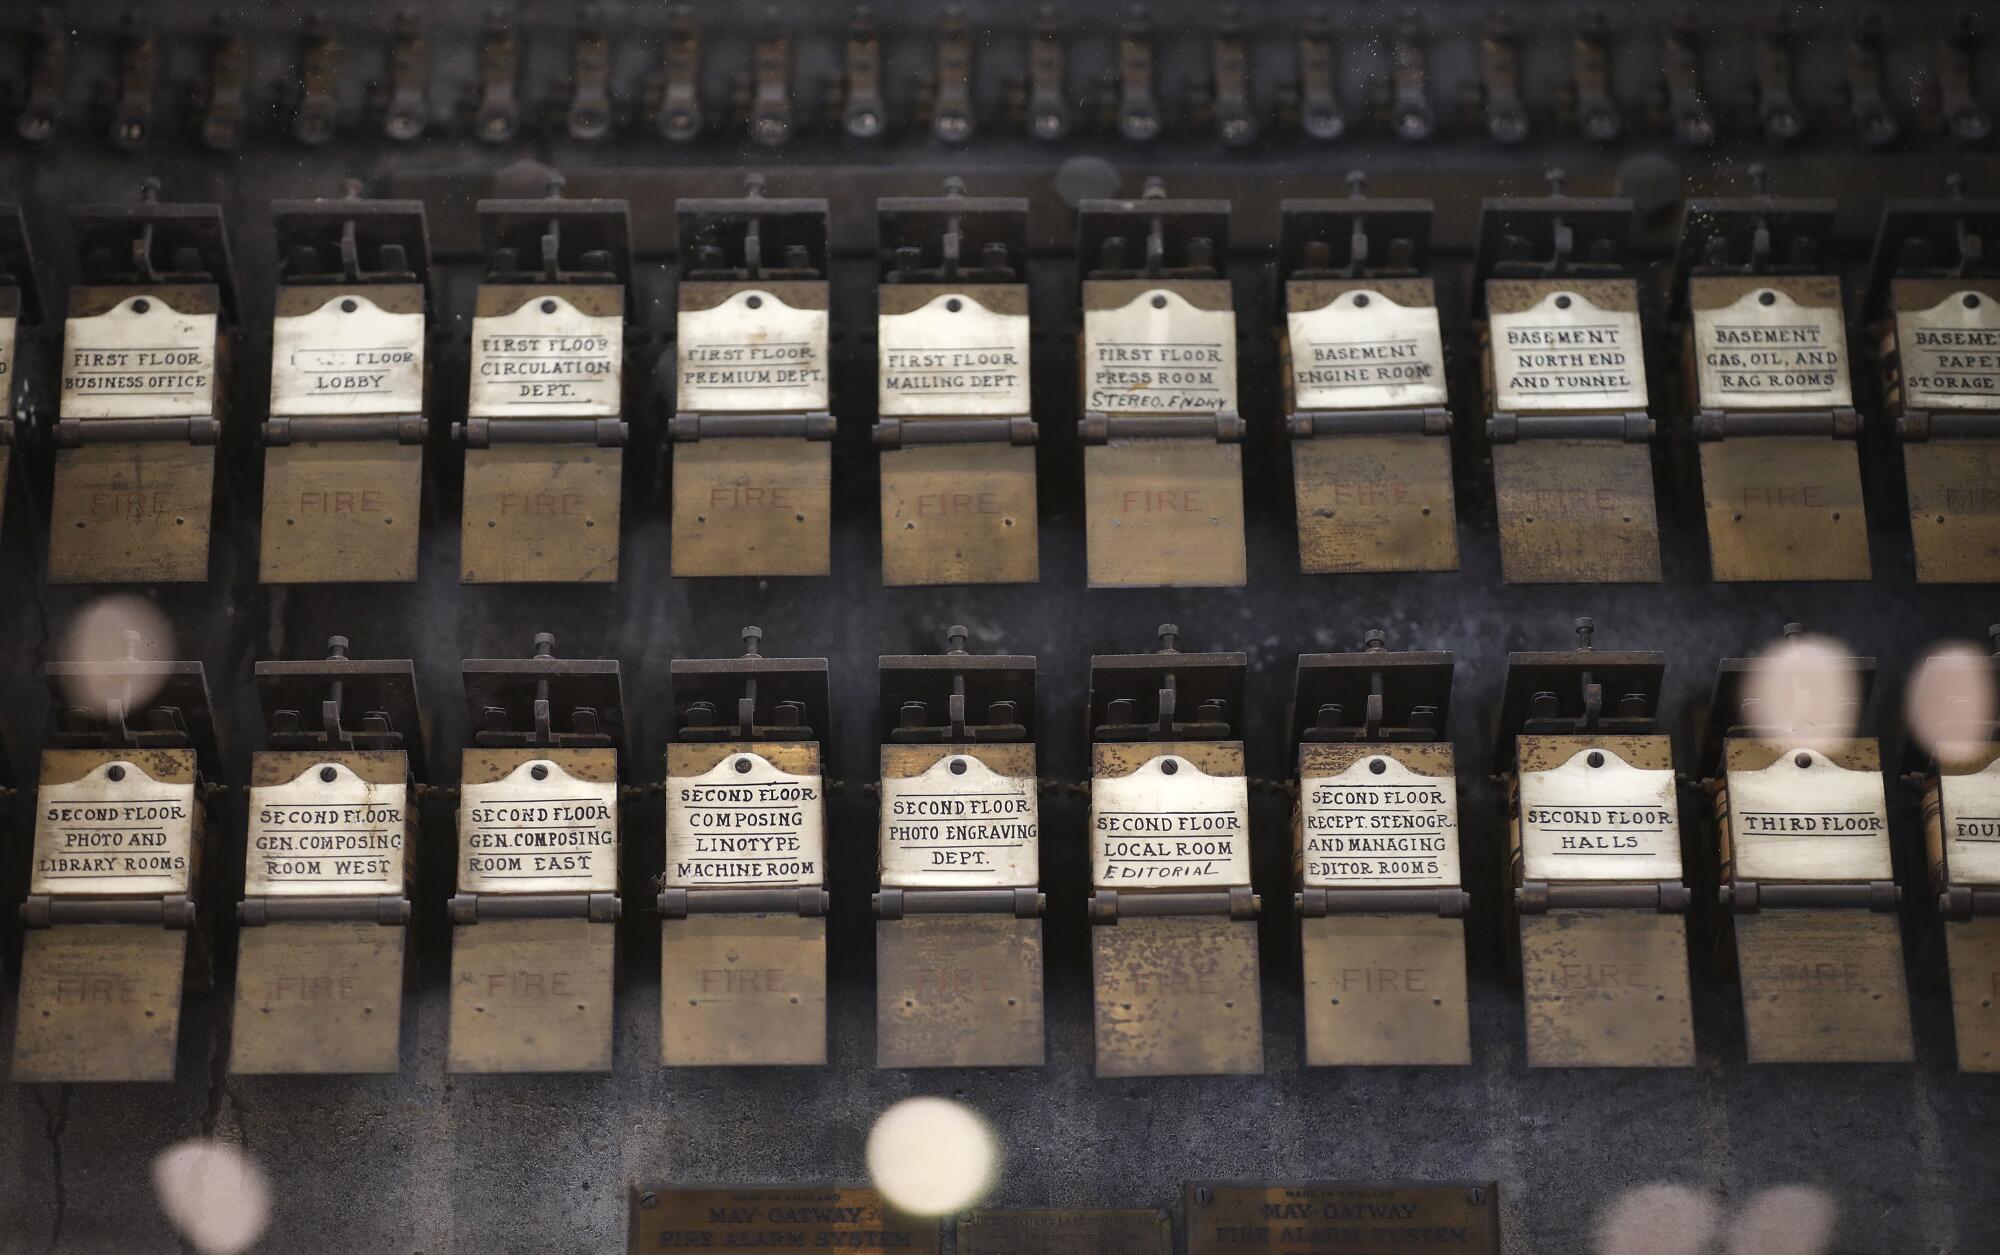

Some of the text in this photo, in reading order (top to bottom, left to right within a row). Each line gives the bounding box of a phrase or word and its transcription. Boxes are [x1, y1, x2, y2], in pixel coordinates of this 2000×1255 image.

[1507, 329, 1619, 344] BASEMENT
[1715, 329, 1821, 344] BASEMENT
[1916, 331, 2000, 346] BASEME
[481, 338, 607, 353] FIRST FLOOR
[1313, 344, 1418, 360] BASEMENT
[74, 352, 202, 367] FIRST FLOOR
[687, 348, 816, 362] FIRST FLOOR
[888, 353, 1019, 368] FIRST FLOOR
[1099, 348, 1223, 363] FIRST FLOOR
[1518, 353, 1625, 366] NORTH END
[1707, 353, 1746, 367] GAS,
[1795, 351, 1838, 365] AND
[480, 361, 611, 375] CIRCULATION
[684, 368, 825, 383] PREMIUM DEPT.
[1298, 364, 1431, 383] ENGINE ROOM
[65, 375, 206, 390] BUSINESS OFFICE
[315, 375, 385, 389] LOBBY
[886, 375, 964, 389] MAILING
[1095, 370, 1213, 384] PRESS ROOM
[1509, 375, 1631, 388] AND TUNNEL
[1721, 372, 1835, 388] RAG ROOMS
[1908, 377, 1994, 390] STORAGE
[520, 384, 576, 397] DEPT.
[710, 487, 793, 510] FIRE
[1122, 489, 1203, 514] FIRE
[1333, 483, 1414, 505] FIRE
[1743, 486, 1823, 509] FIRE
[90, 492, 171, 515] FIRE
[300, 491, 385, 514] FIRE
[502, 494, 584, 516] FIRE
[917, 493, 1002, 515] FIRE
[680, 788, 818, 803] SECOND FLOOR
[1312, 790, 1446, 805] SECOND FLOOR
[47, 806, 186, 821] SECOND FLOOR
[471, 806, 611, 823] SECOND FLOOR
[893, 800, 1032, 816] SECOND FLOOR
[260, 809, 403, 825] SECOND FLOOR
[690, 812, 803, 828] COMPOSING
[1098, 816, 1241, 831] SECOND FLOOR
[1307, 815, 1457, 829] RECEPT. STENOGR.
[1528, 810, 1673, 825] SECOND FLOOR
[1745, 816, 1884, 831] THIRD FLOOR
[65, 833, 167, 848] PHOTO AND
[889, 825, 1038, 842] PHOTO ENGRAVING
[695, 837, 801, 852] LINOTYPE
[1104, 841, 1233, 857] LOCAL ROOM
[1307, 838, 1446, 852] AND MANAGING
[1561, 836, 1639, 849] HALLS
[38, 857, 185, 872] LIBRARY ROOMS
[469, 856, 591, 872] ROOM EAST
[931, 851, 990, 865] DEPT.
[266, 860, 390, 876] ROOM WEST
[678, 861, 815, 877] MACHINE ROOM
[1102, 862, 1219, 879] EDITORIAL
[1308, 862, 1439, 876] EDITOR ROOMS
[702, 969, 787, 993] FIRE
[1342, 969, 1428, 992] FIRE
[1562, 964, 1648, 988] FIRE
[275, 977, 359, 1000] FIRE
[487, 973, 574, 997] FIRE
[660, 1231, 913, 1248] FIRE ALARM SYSTEM
[1216, 1226, 1469, 1243] FIRE ALARM SYSTEM
